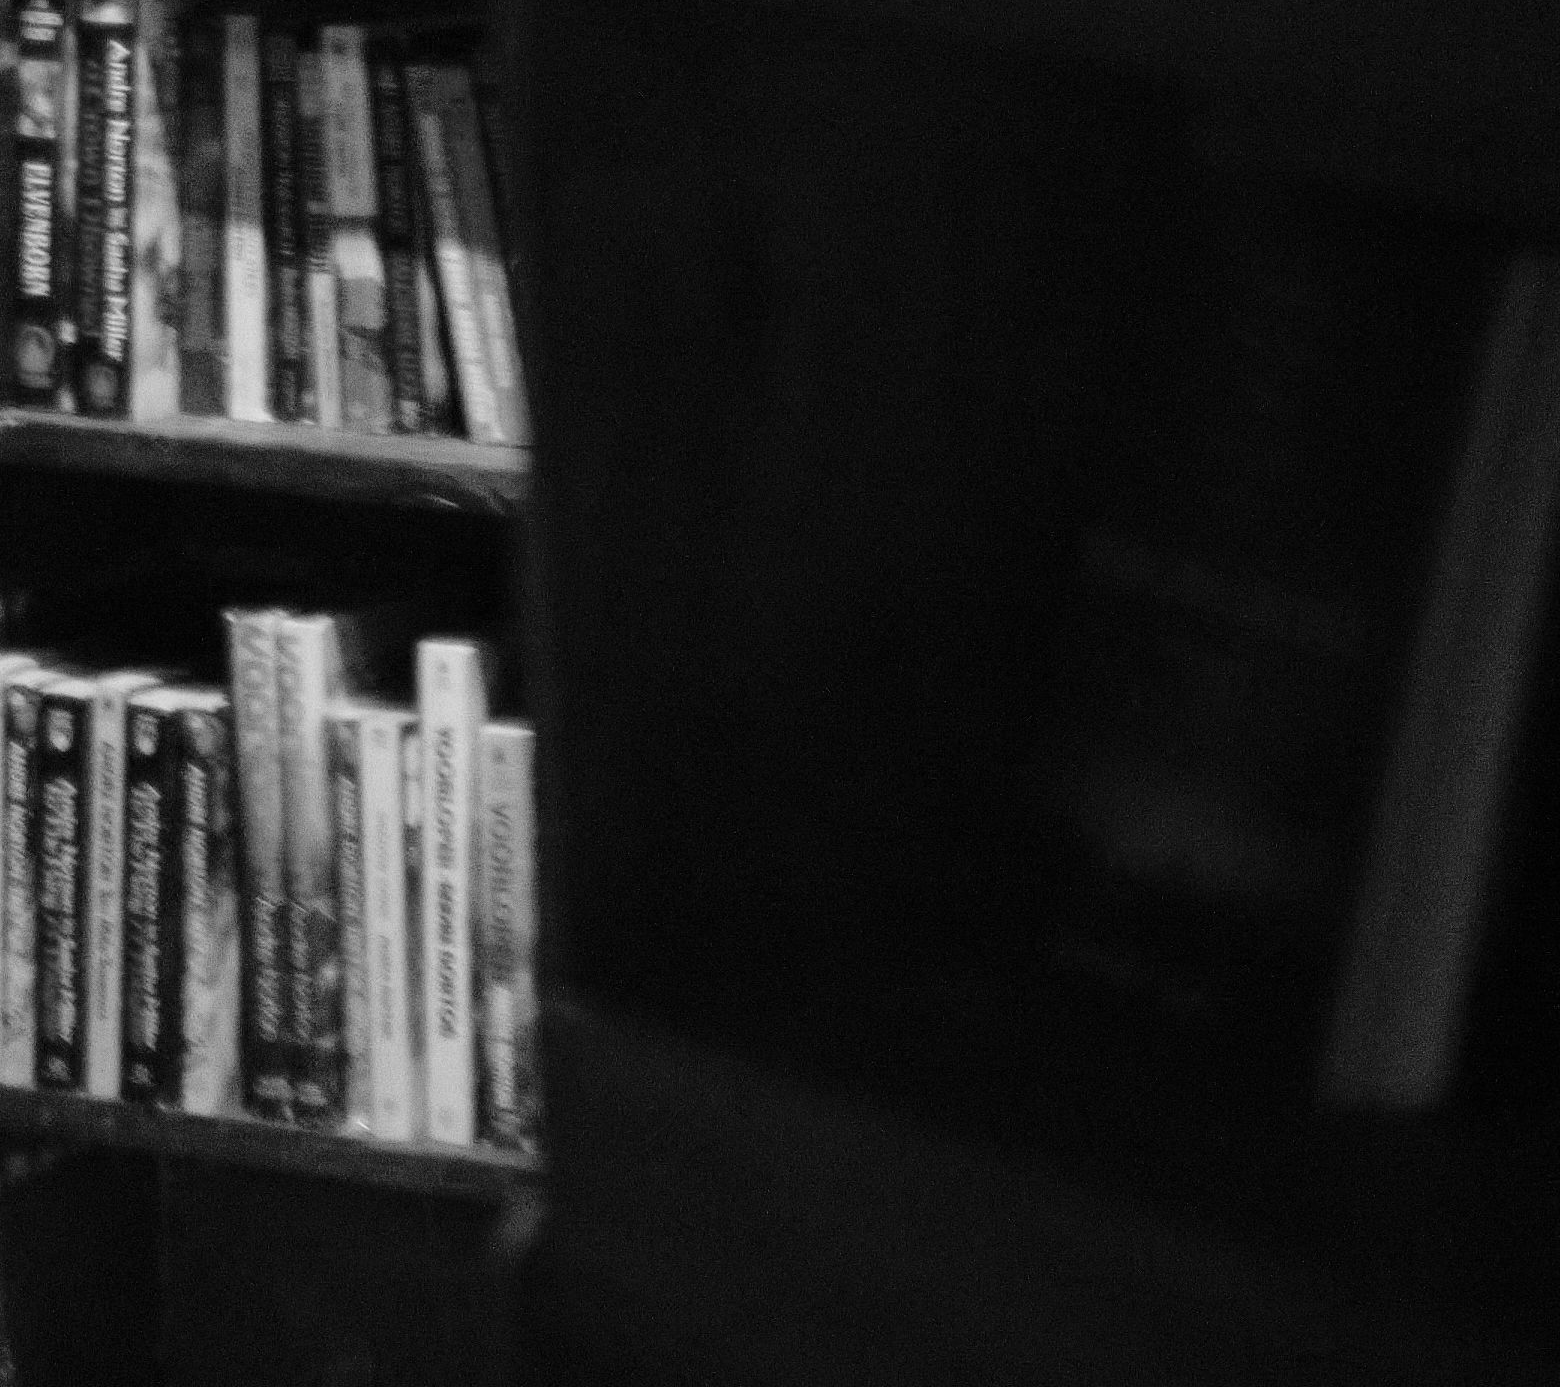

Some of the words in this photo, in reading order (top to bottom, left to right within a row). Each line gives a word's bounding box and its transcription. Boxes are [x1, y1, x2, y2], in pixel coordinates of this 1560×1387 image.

[105, 117, 132, 202] Norton
[20, 160, 52, 298] ELVENBORN
[105, 296, 131, 361] Miller
